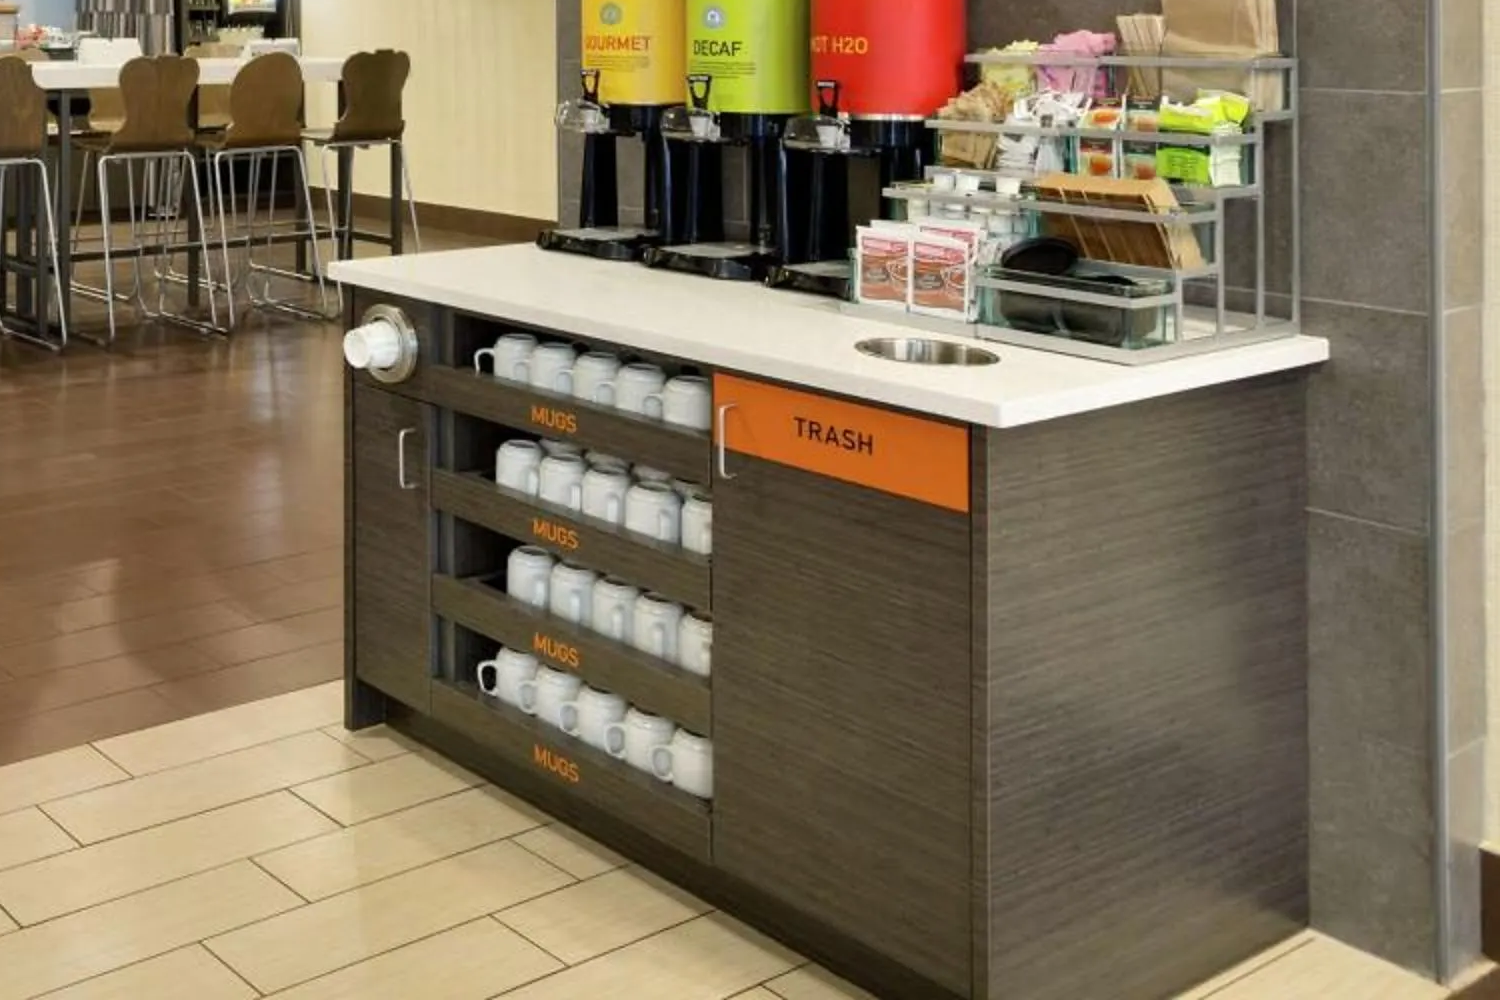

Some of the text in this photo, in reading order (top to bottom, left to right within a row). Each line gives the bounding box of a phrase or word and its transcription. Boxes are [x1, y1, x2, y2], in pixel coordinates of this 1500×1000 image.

[693, 39, 743, 57] DECAF
[832, 35, 869, 55] H2O
[531, 405, 577, 433] MUGS
[793, 415, 874, 457] TRASH
[533, 518, 579, 549] MUGS
[533, 632, 580, 668] MUGS
[533, 744, 580, 783] MUGS
